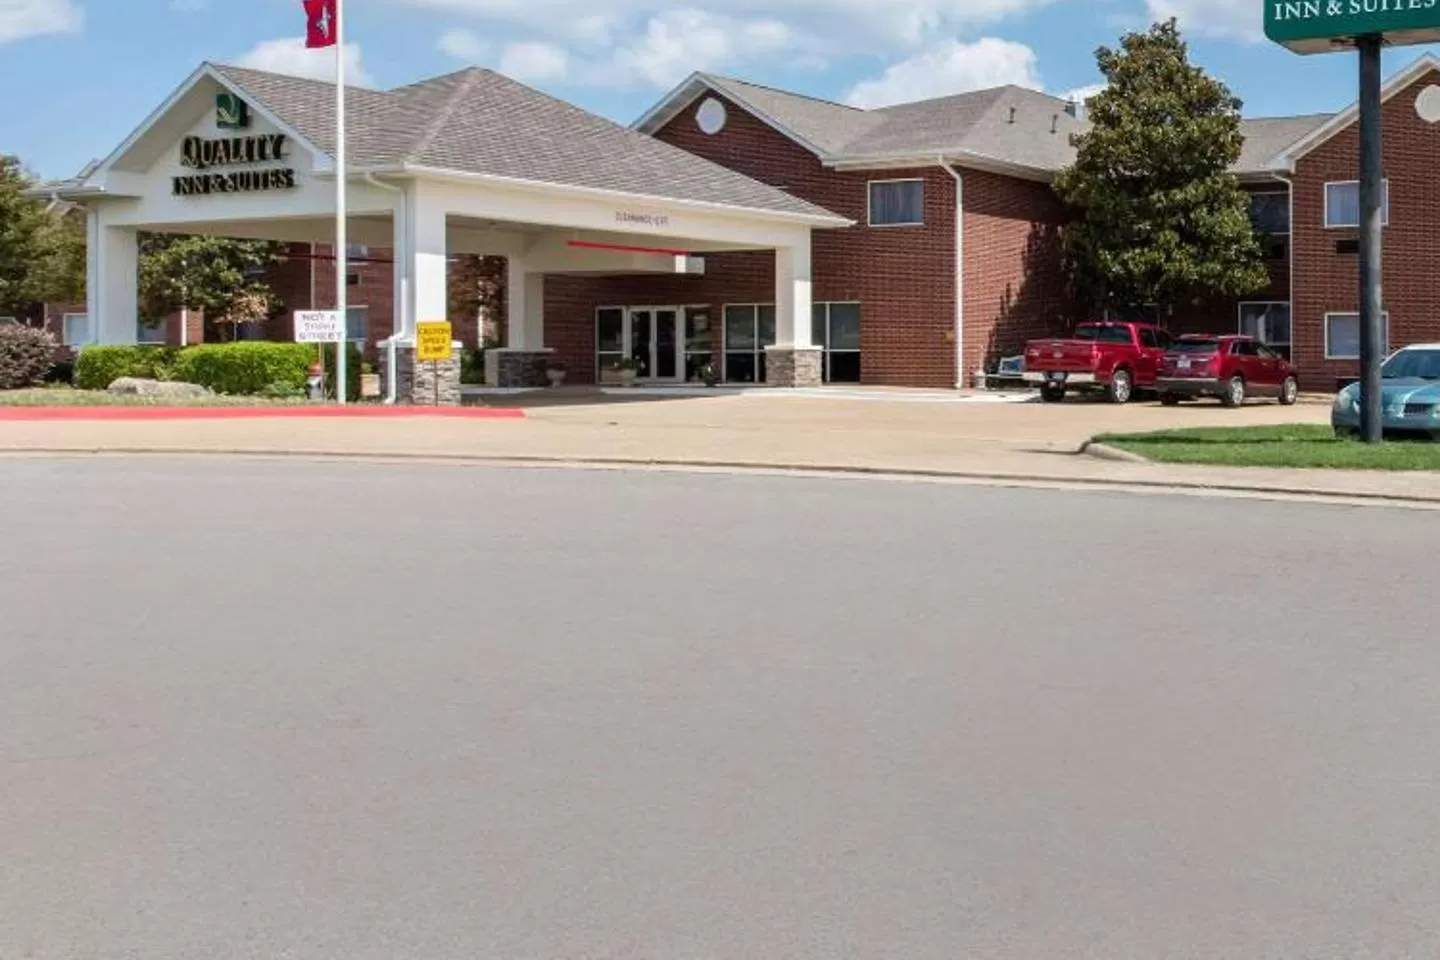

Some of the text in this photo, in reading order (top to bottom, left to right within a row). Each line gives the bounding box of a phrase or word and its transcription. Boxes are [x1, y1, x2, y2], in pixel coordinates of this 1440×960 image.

[1274, 0, 1320, 20] INN
[181, 134, 286, 169] QUALITY
[171, 175, 211, 195] INN
[228, 168, 295, 193] SUITES
